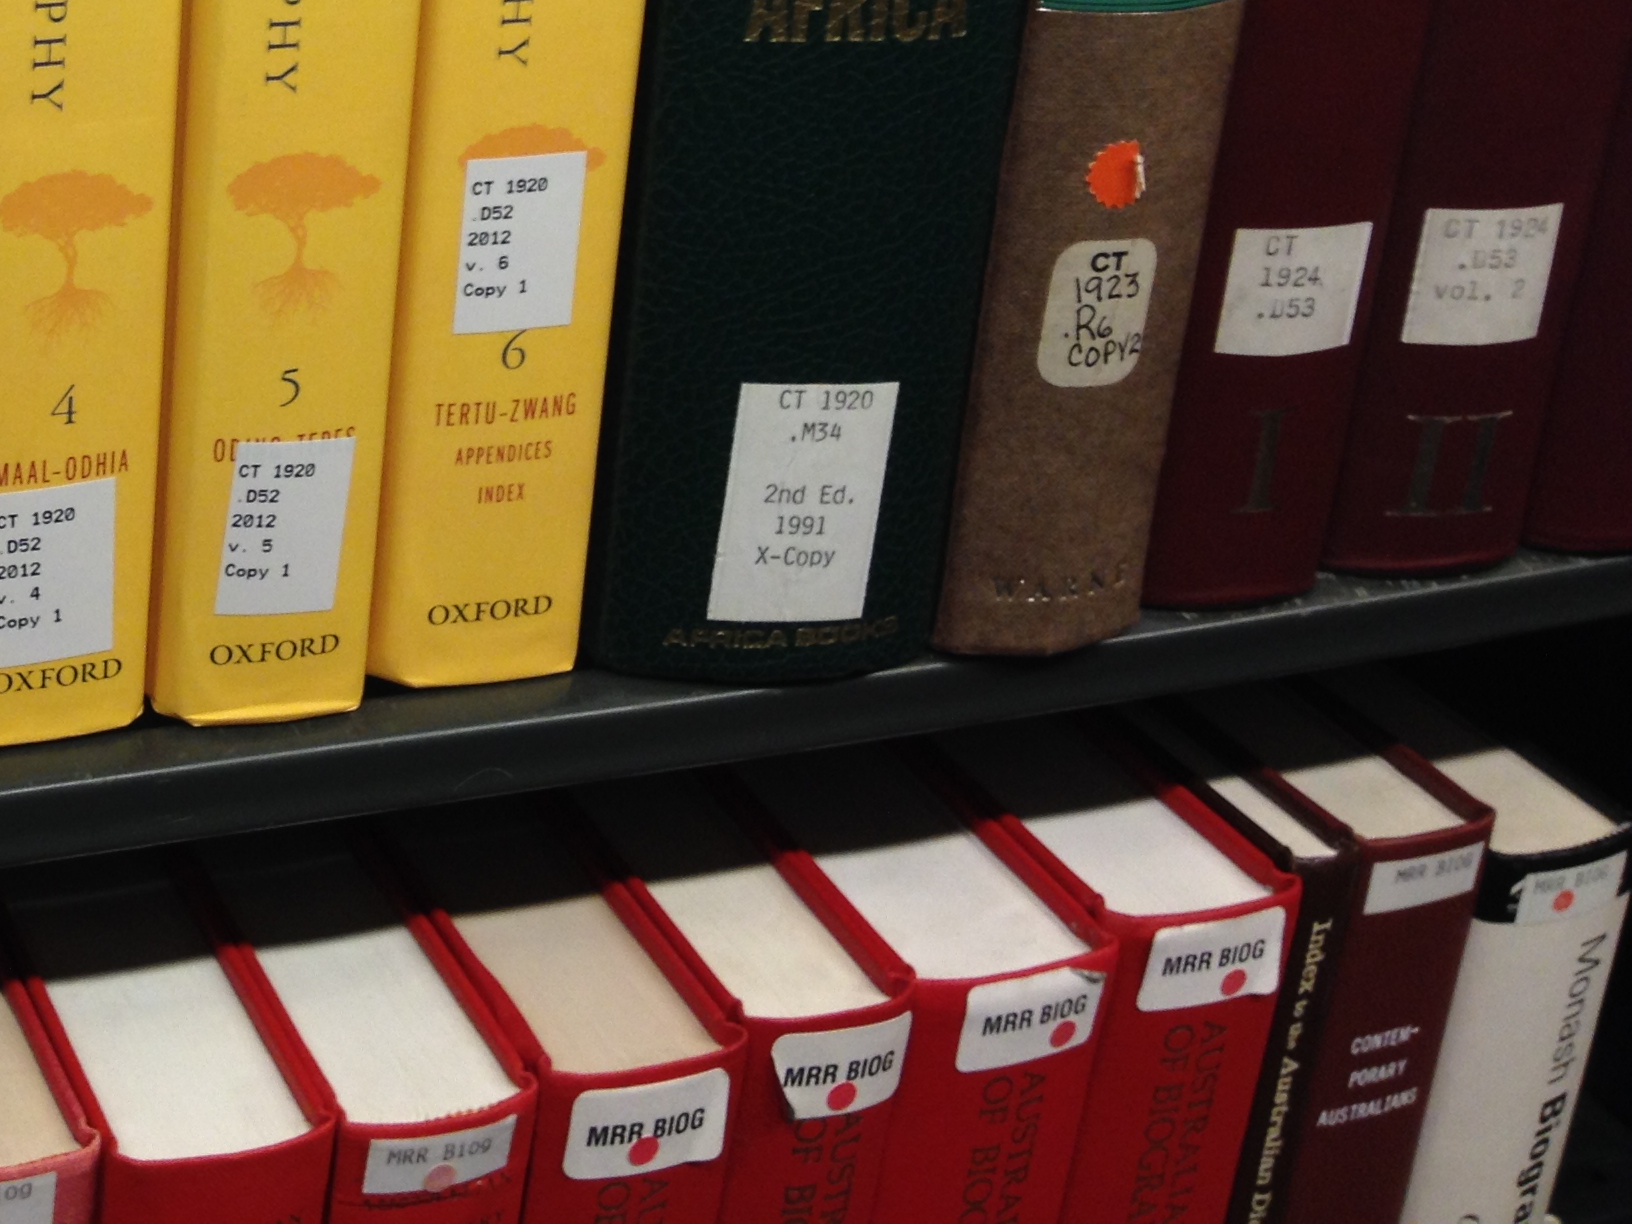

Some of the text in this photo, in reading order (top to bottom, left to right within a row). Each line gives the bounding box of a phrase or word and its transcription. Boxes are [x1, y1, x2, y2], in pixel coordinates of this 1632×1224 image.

[472, 177, 549, 195] CT 1920
[472, 205, 514, 222] .D52
[468, 231, 512, 246] 2012
[1443, 217, 1548, 240] CT 1924
[1266, 236, 1296, 257] CT
[498, 255, 509, 269] 6
[1091, 251, 1128, 272] CT
[1259, 266, 1321, 287] 1924
[463, 283, 506, 298] Copy
[1074, 276, 1140, 302] 1923
[1434, 280, 1527, 302] vol. 2
[501, 329, 528, 370] 6
[279, 368, 301, 407] 5
[50, 384, 77, 425] 4
[434, 393, 577, 427] TERTU-ZWANG
[778, 390, 875, 410] CT 1920
[790, 422, 842, 442] .M34
[455, 441, 553, 466] APPENDICES
[238, 463, 316, 478] CT 1920
[237, 489, 281, 504] .D52
[477, 483, 526, 504] INDEX
[764, 485, 854, 505] 2nd Ed.
[32, 507, 75, 526] 1920
[231, 514, 277, 529] 2012
[774, 516, 826, 536] 1991
[262, 539, 273, 553] 5
[755, 547, 836, 568] X-Copy
[224, 564, 269, 579] Copy
[30, 587, 40, 601] 4
[427, 595, 553, 627] OXFORD
[209, 633, 340, 666] OXFORD
[1162, 939, 1266, 976] MRR BIOG
[1298, 918, 1333, 995] Index
[982, 994, 1087, 1036] MRR BIOG
[1547, 932, 1608, 1085] Monash
[1351, 1024, 1420, 1055] CONTEM-
[783, 1050, 895, 1087] MRR BIOG
[1348, 1059, 1407, 1088] PORARY
[1317, 1086, 1418, 1127] AUSTRALIANS
[586, 1108, 705, 1147] MRR BIOG
[1256, 1056, 1300, 1186] Australian
[386, 1147, 429, 1165] MRR
